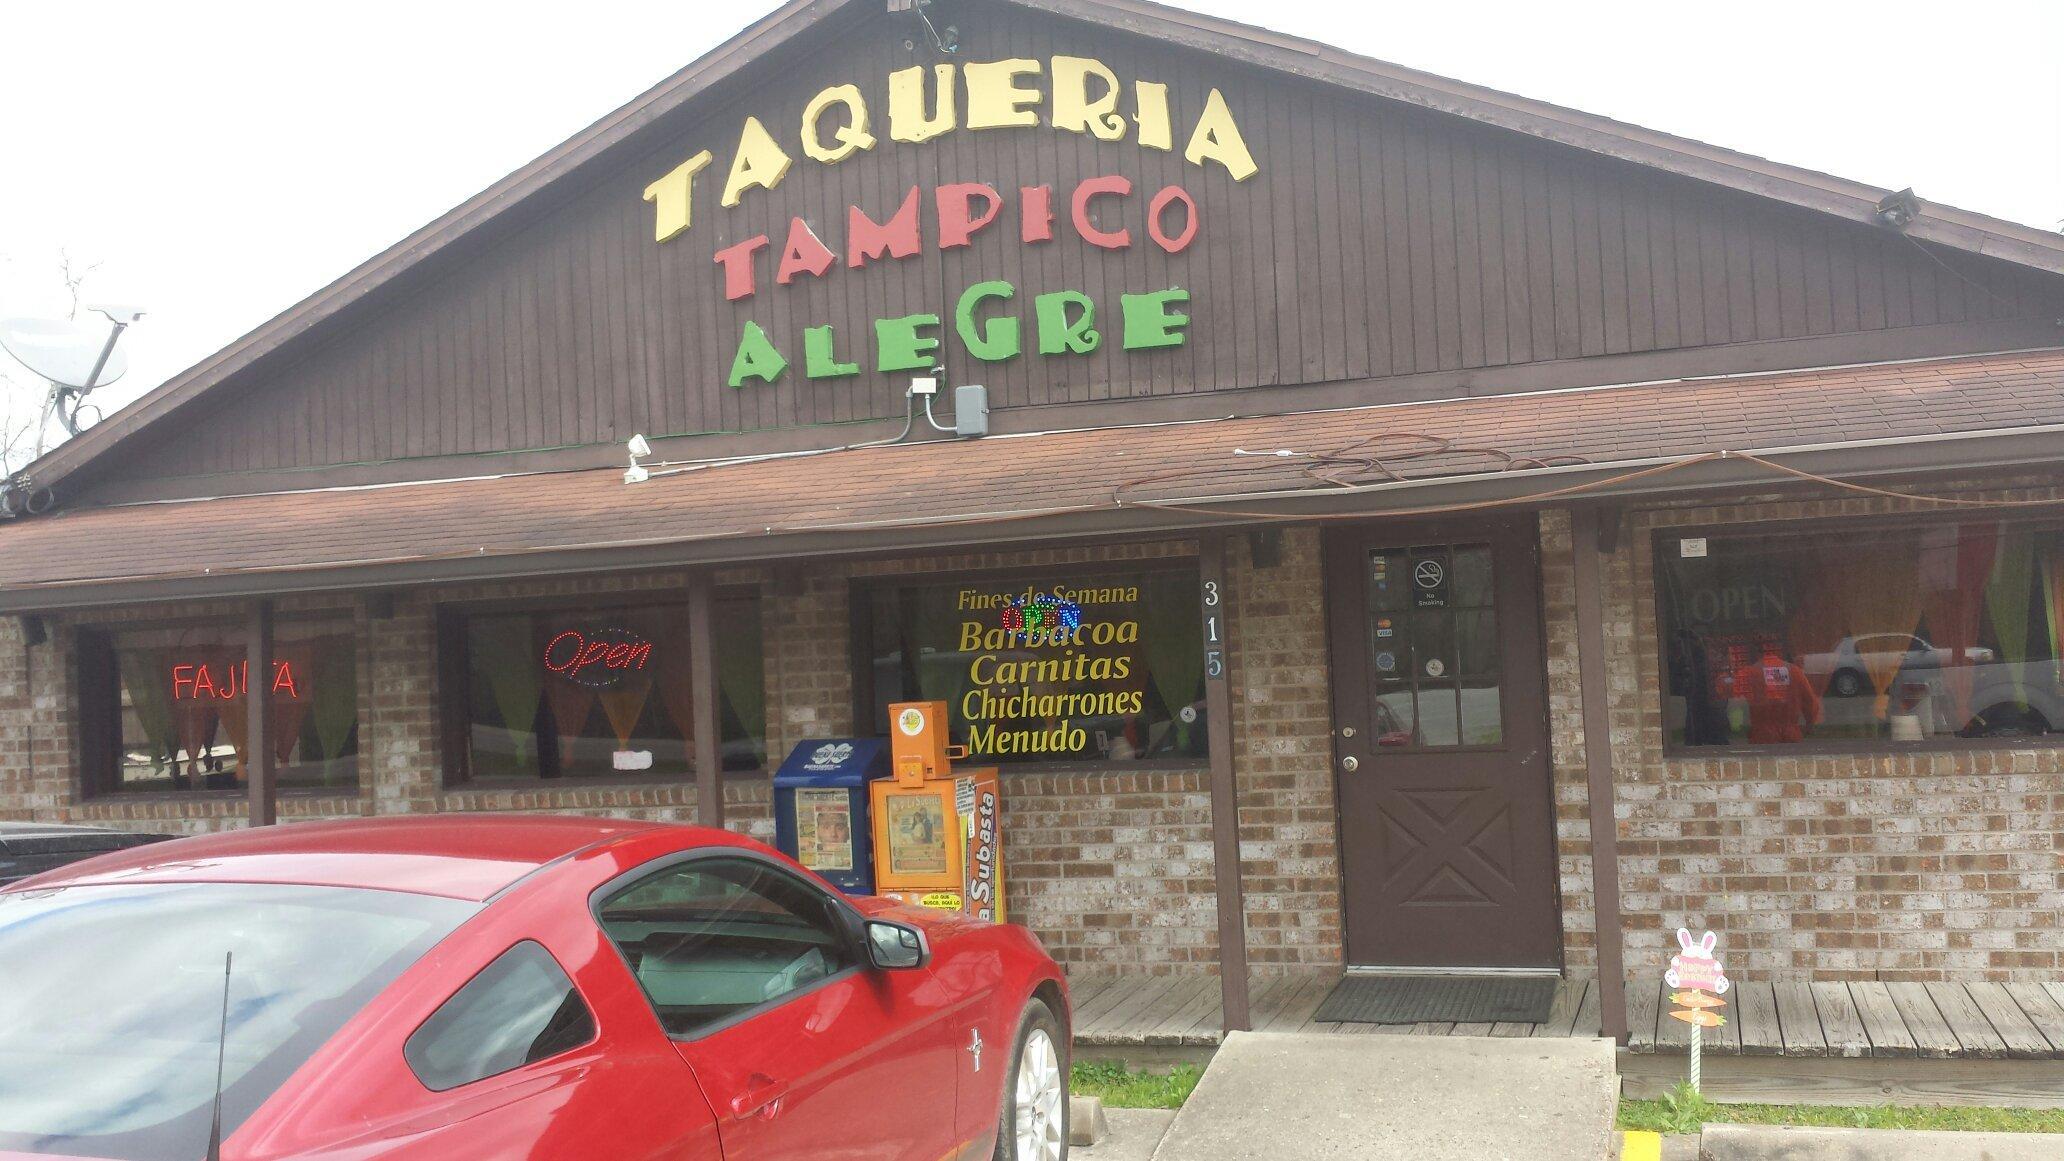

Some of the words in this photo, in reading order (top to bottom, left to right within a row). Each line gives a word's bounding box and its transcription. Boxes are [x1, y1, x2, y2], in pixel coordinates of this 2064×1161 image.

[643, 55, 1258, 242] TAQUERIA
[714, 175, 1199, 301] TAMPICO
[728, 280, 1191, 387] ALEGRE
[958, 589, 1012, 610] Fines
[1021, 586, 1044, 605] de
[1053, 585, 1138, 606] Semana
[1693, 584, 1787, 621] OPEN
[959, 617, 1138, 651] Barbacoa
[1002, 607, 1080, 632] OPEN
[545, 632, 652, 676] Open
[970, 650, 1131, 686] Carnitas
[174, 660, 297, 699] FAJIA
[962, 686, 1143, 721] Chicharrones
[968, 719, 1087, 754] Menudo
[970, 793, 994, 904] Subasta
